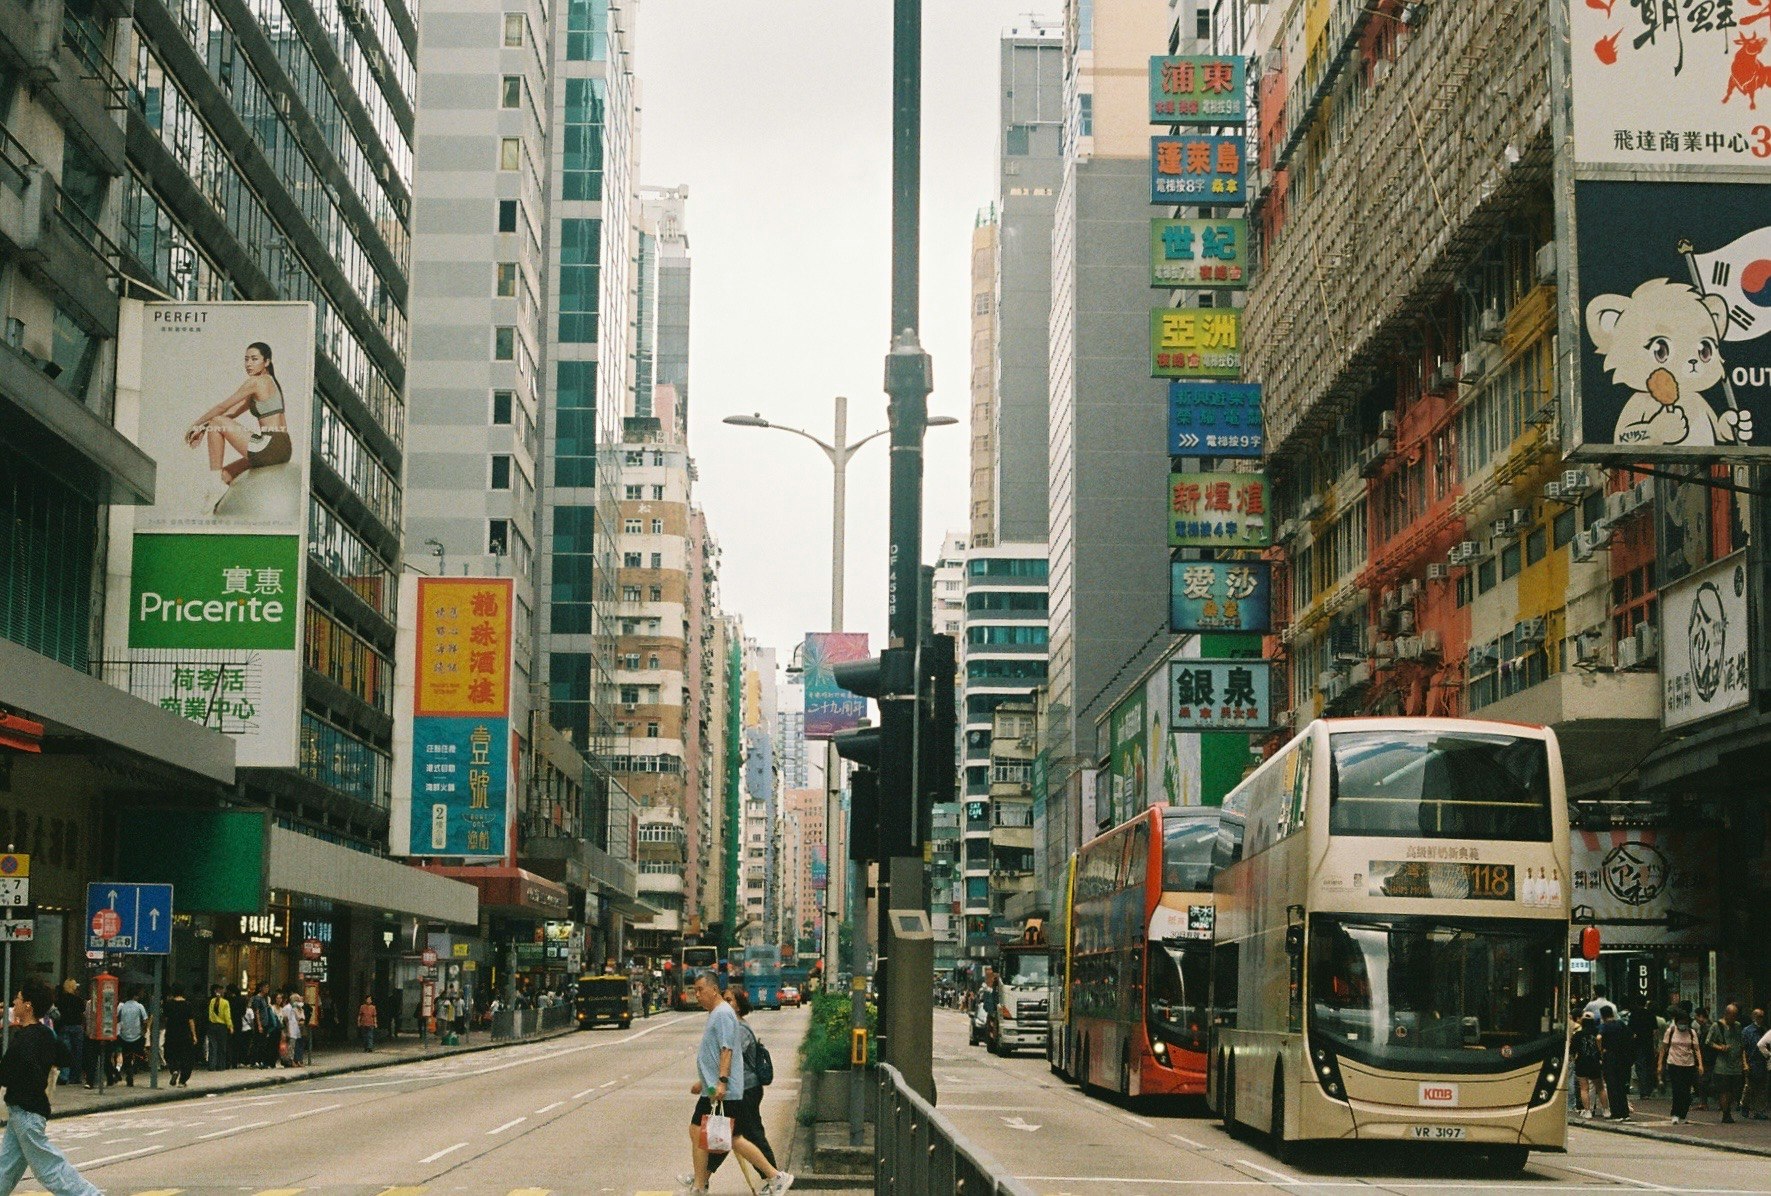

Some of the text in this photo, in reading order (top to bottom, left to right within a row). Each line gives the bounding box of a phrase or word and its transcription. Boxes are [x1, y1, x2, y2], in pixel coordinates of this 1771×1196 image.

[1161, 60, 1234, 94] 浦東
[1614, 129, 1749, 153] 飛達商業中心
[1157, 140, 1239, 175] 蓬萊島
[1162, 225, 1236, 260] 世紀
[154, 311, 208, 323] PERFIT
[1161, 314, 1236, 349] 亞洲
[1731, 366, 1771, 387] OU
[1206, 435, 1261, 448] 電梯按9字
[221, 565, 284, 595] 實惠
[1183, 565, 1258, 599] 愛莎
[140, 592, 283, 622] Pricerite
[172, 669, 245, 692] 荷李活
[1176, 667, 1257, 706] 銀泉
[160, 698, 256, 720] 商業中心
[14, 880, 21, 890] 7
[1472, 865, 1509, 896] 118
[14, 895, 21, 905] 8
[1424, 1088, 1453, 1100] KMB
[1415, 1127, 1461, 1138] VR 3197
